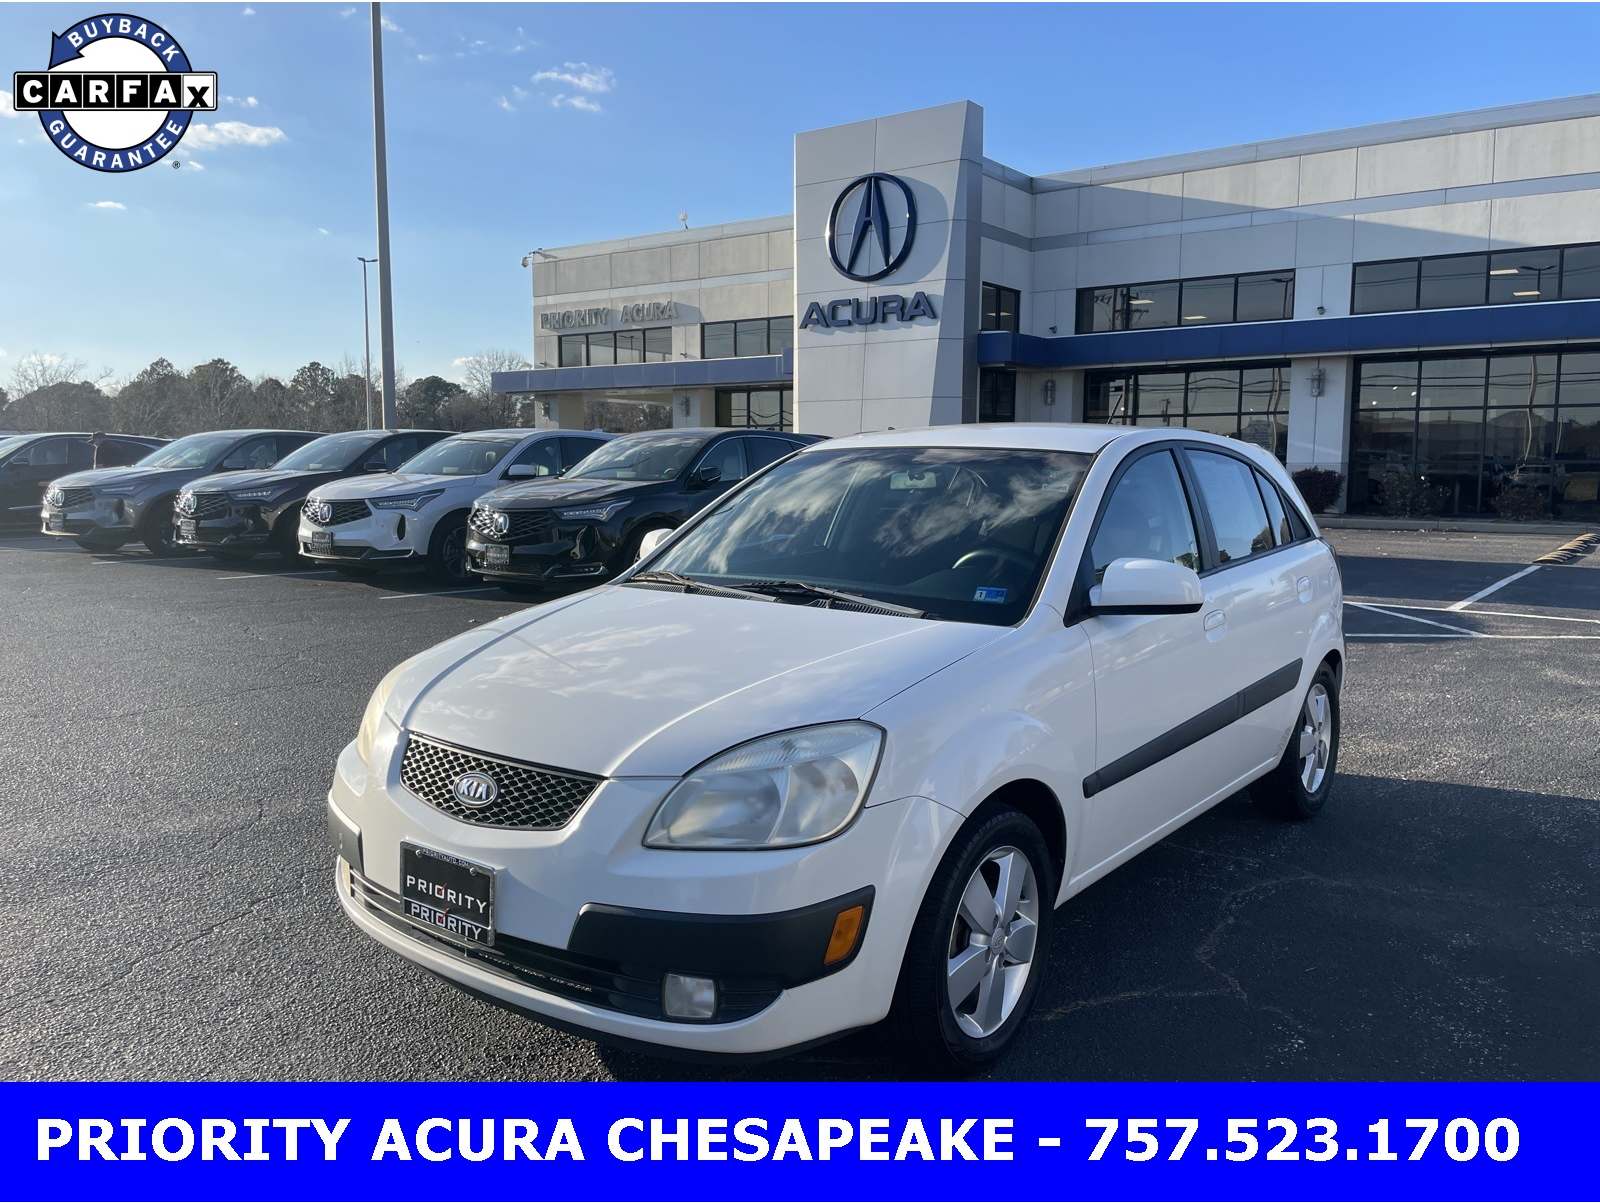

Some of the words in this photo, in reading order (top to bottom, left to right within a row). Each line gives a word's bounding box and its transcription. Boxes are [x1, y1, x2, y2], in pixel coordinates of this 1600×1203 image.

[541, 307, 609, 329] PRIORITY
[620, 300, 679, 322] ACURA
[799, 291, 936, 329] ACURA
[459, 778, 488, 800] KIA
[406, 874, 487, 914] PRIORITY
[410, 902, 482, 940] PRIORITY
